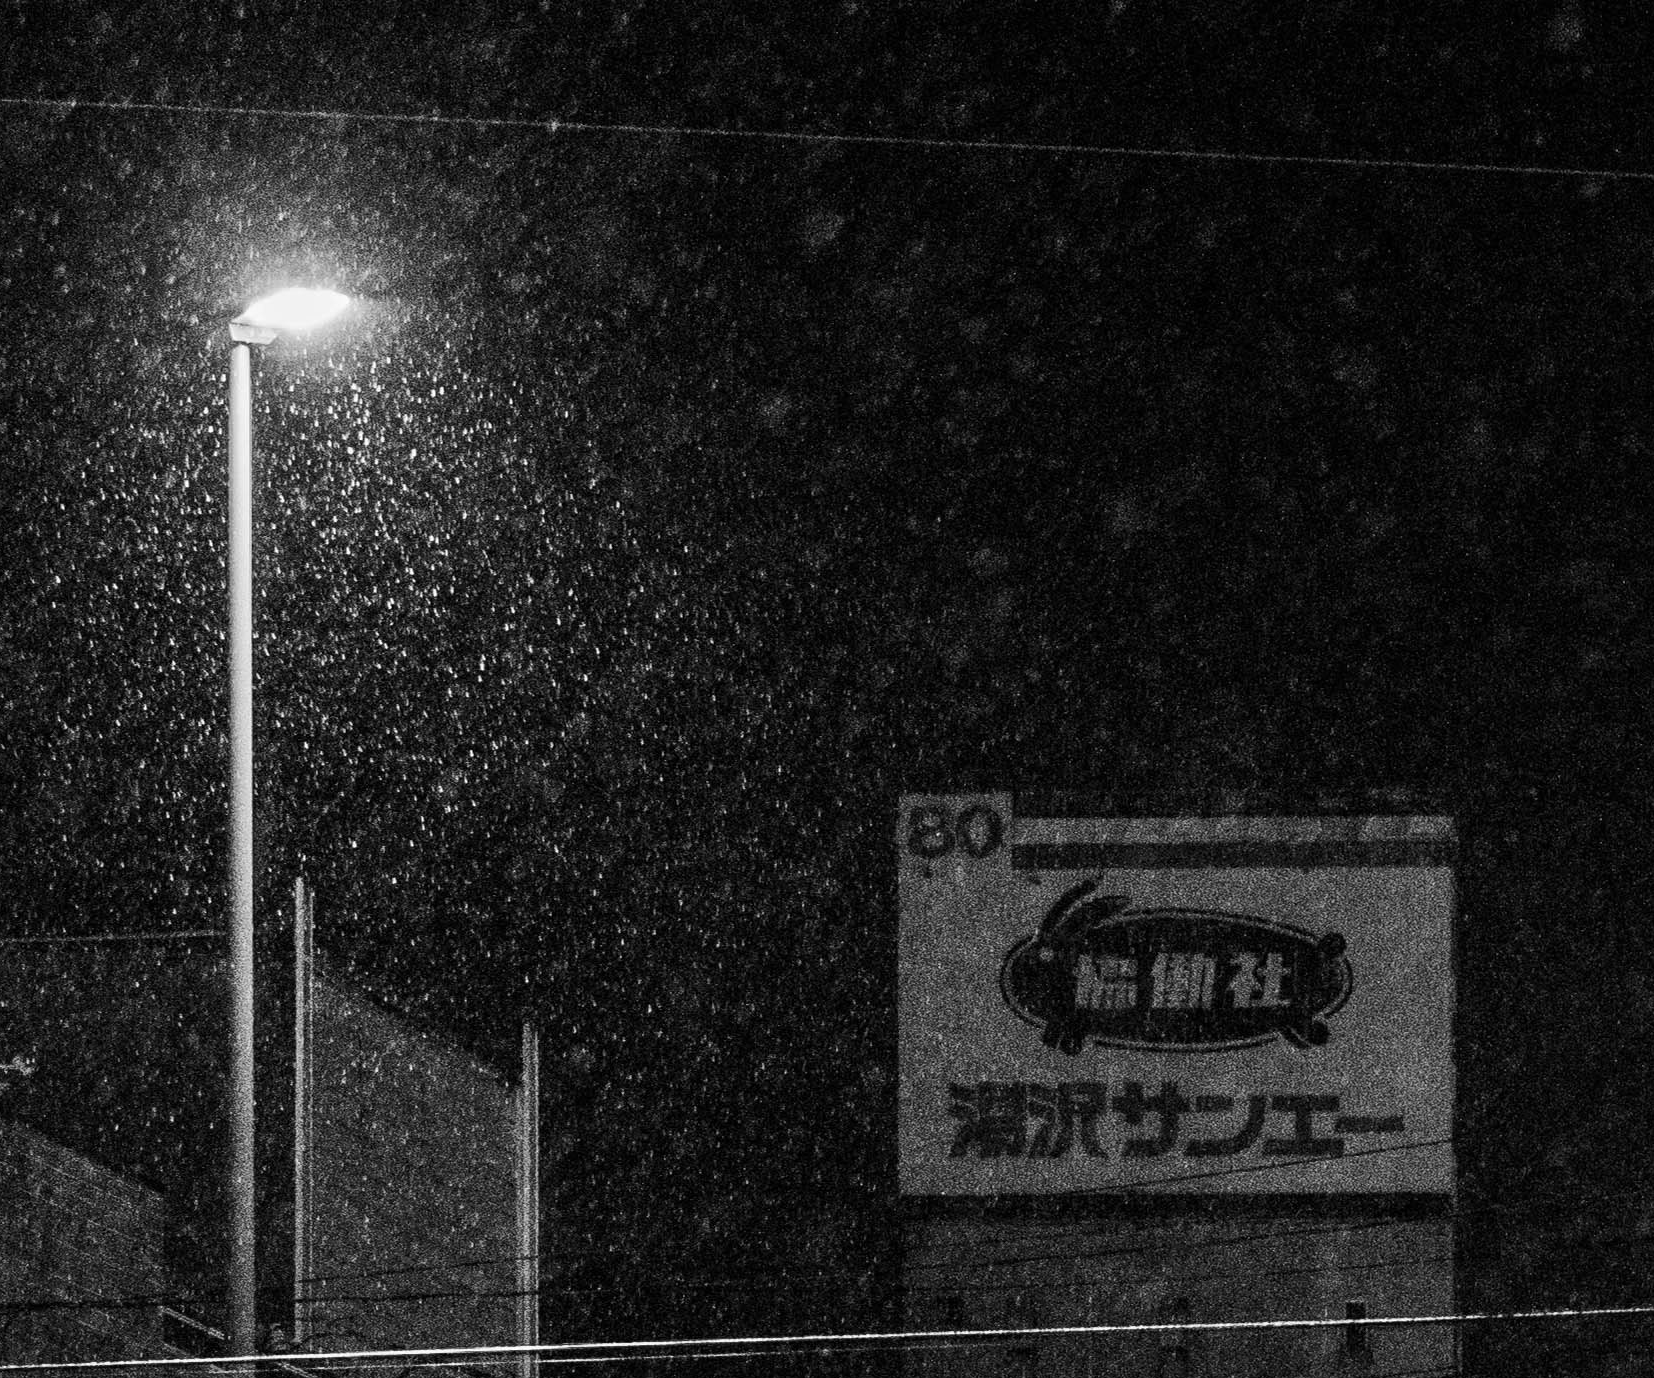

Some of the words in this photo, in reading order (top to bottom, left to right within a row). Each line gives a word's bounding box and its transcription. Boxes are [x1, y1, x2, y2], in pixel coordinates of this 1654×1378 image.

[946, 1080, 1407, 1160] 湯沢サンエー
